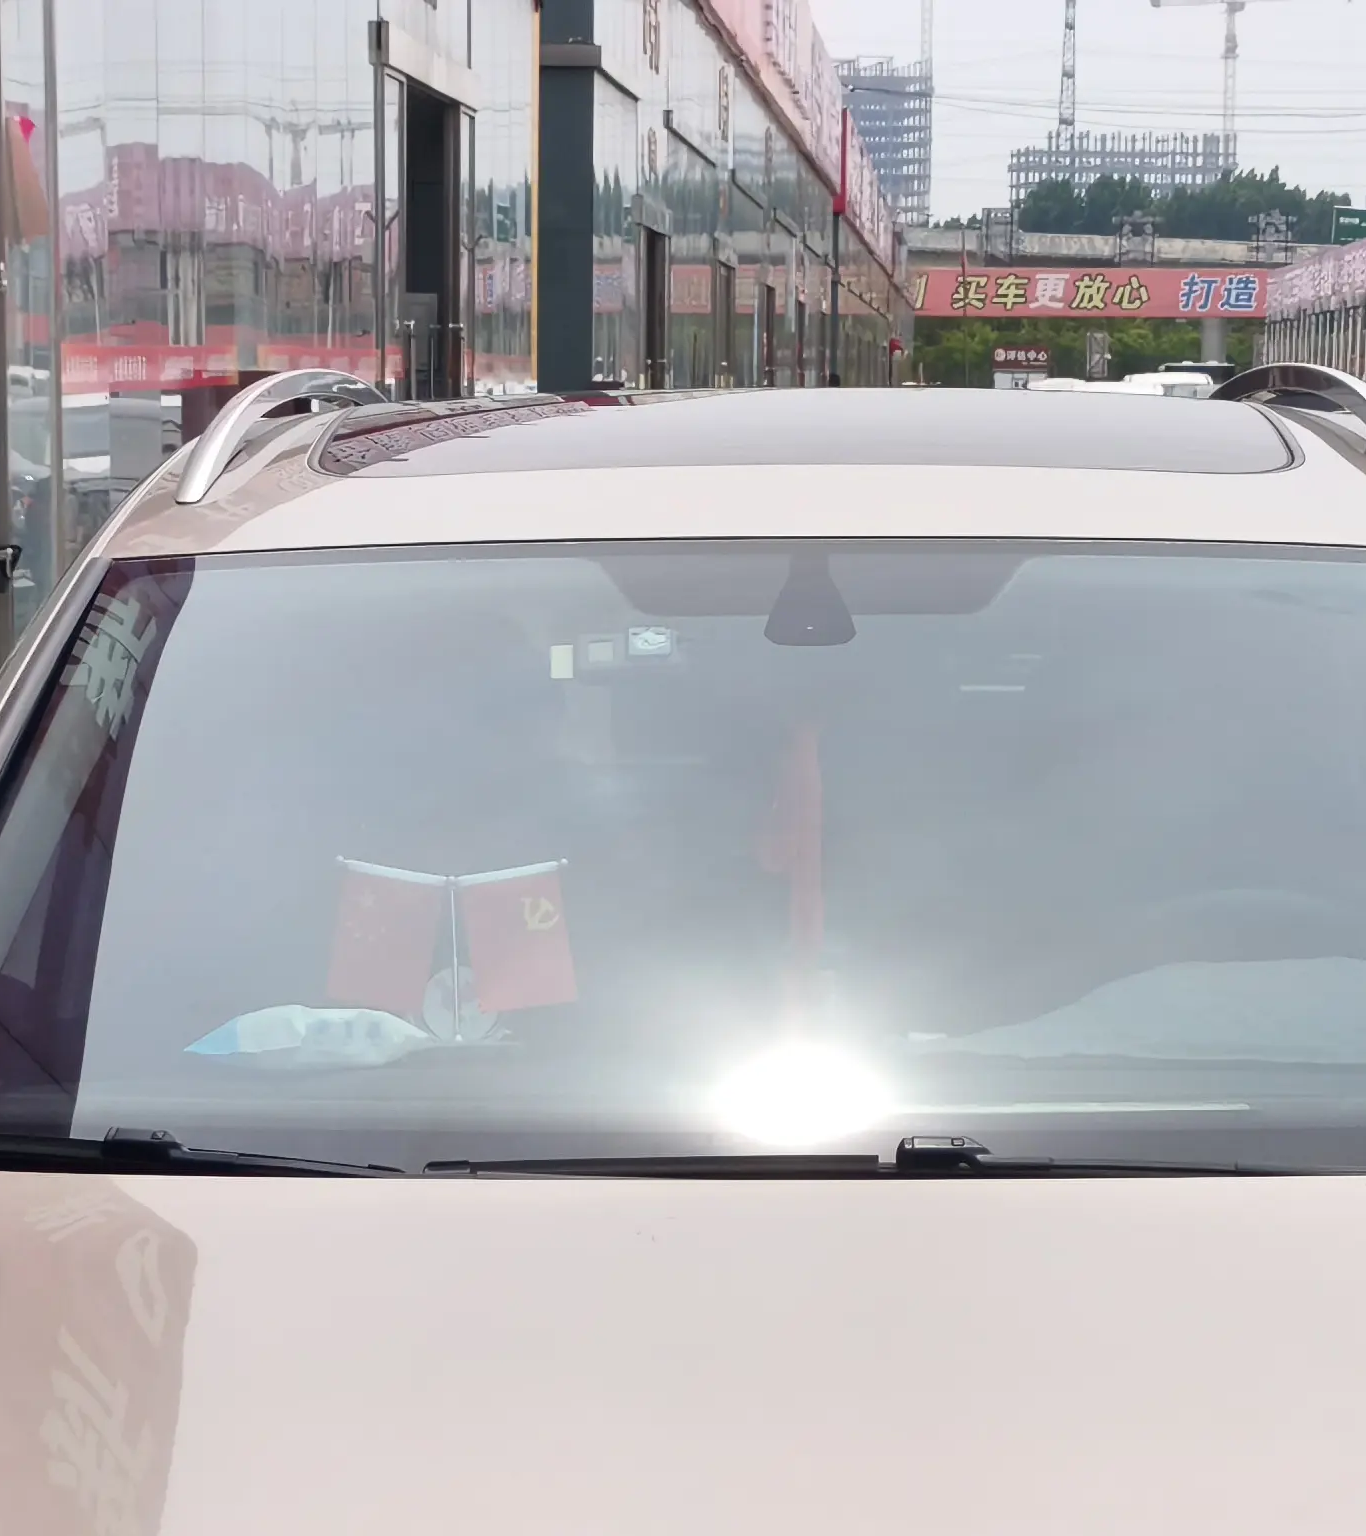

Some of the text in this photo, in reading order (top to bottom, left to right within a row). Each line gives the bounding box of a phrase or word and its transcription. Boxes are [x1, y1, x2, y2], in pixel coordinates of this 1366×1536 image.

[950, 272, 1149, 310] 买车更放心
[1178, 272, 1260, 312] 打造
